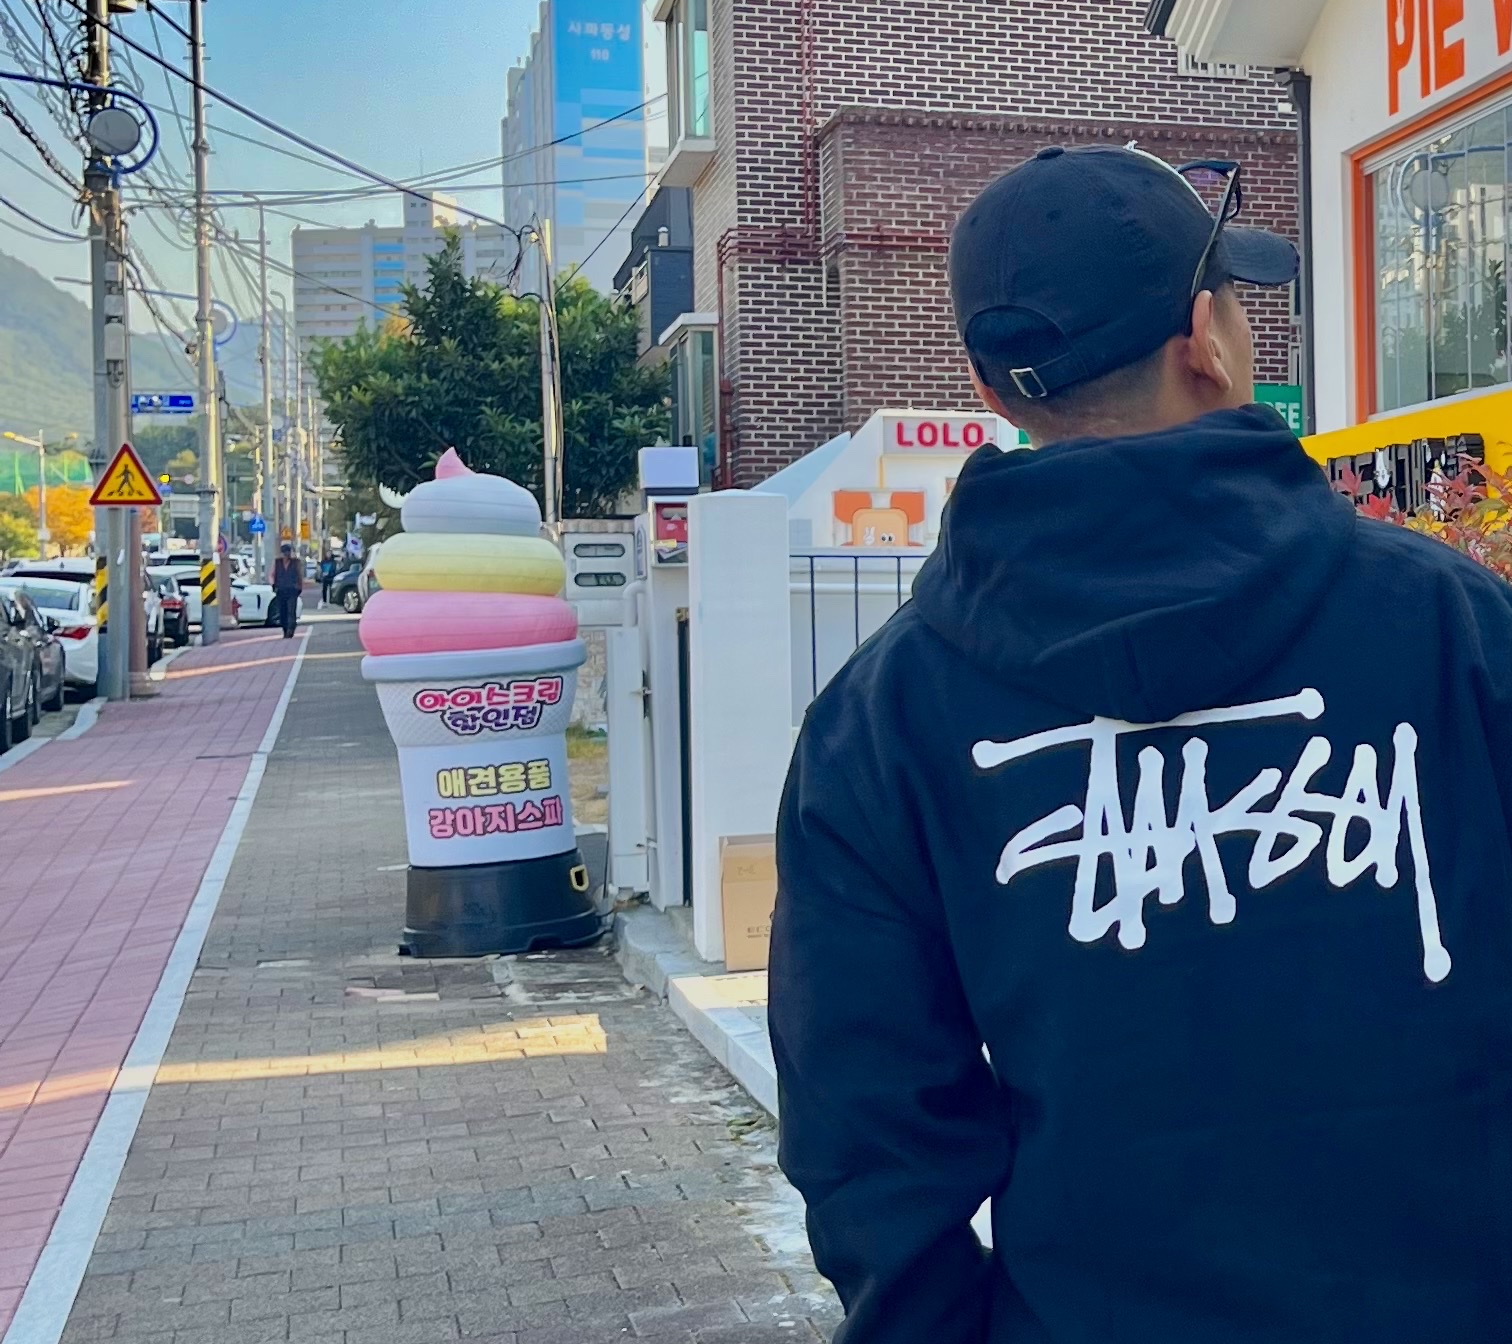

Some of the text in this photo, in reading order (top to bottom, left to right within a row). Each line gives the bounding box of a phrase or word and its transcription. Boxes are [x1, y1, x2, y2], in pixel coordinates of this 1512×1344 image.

[897, 421, 984, 447] LOLO
[437, 758, 552, 798] 애견용품
[428, 795, 563, 839] 강아지스파
